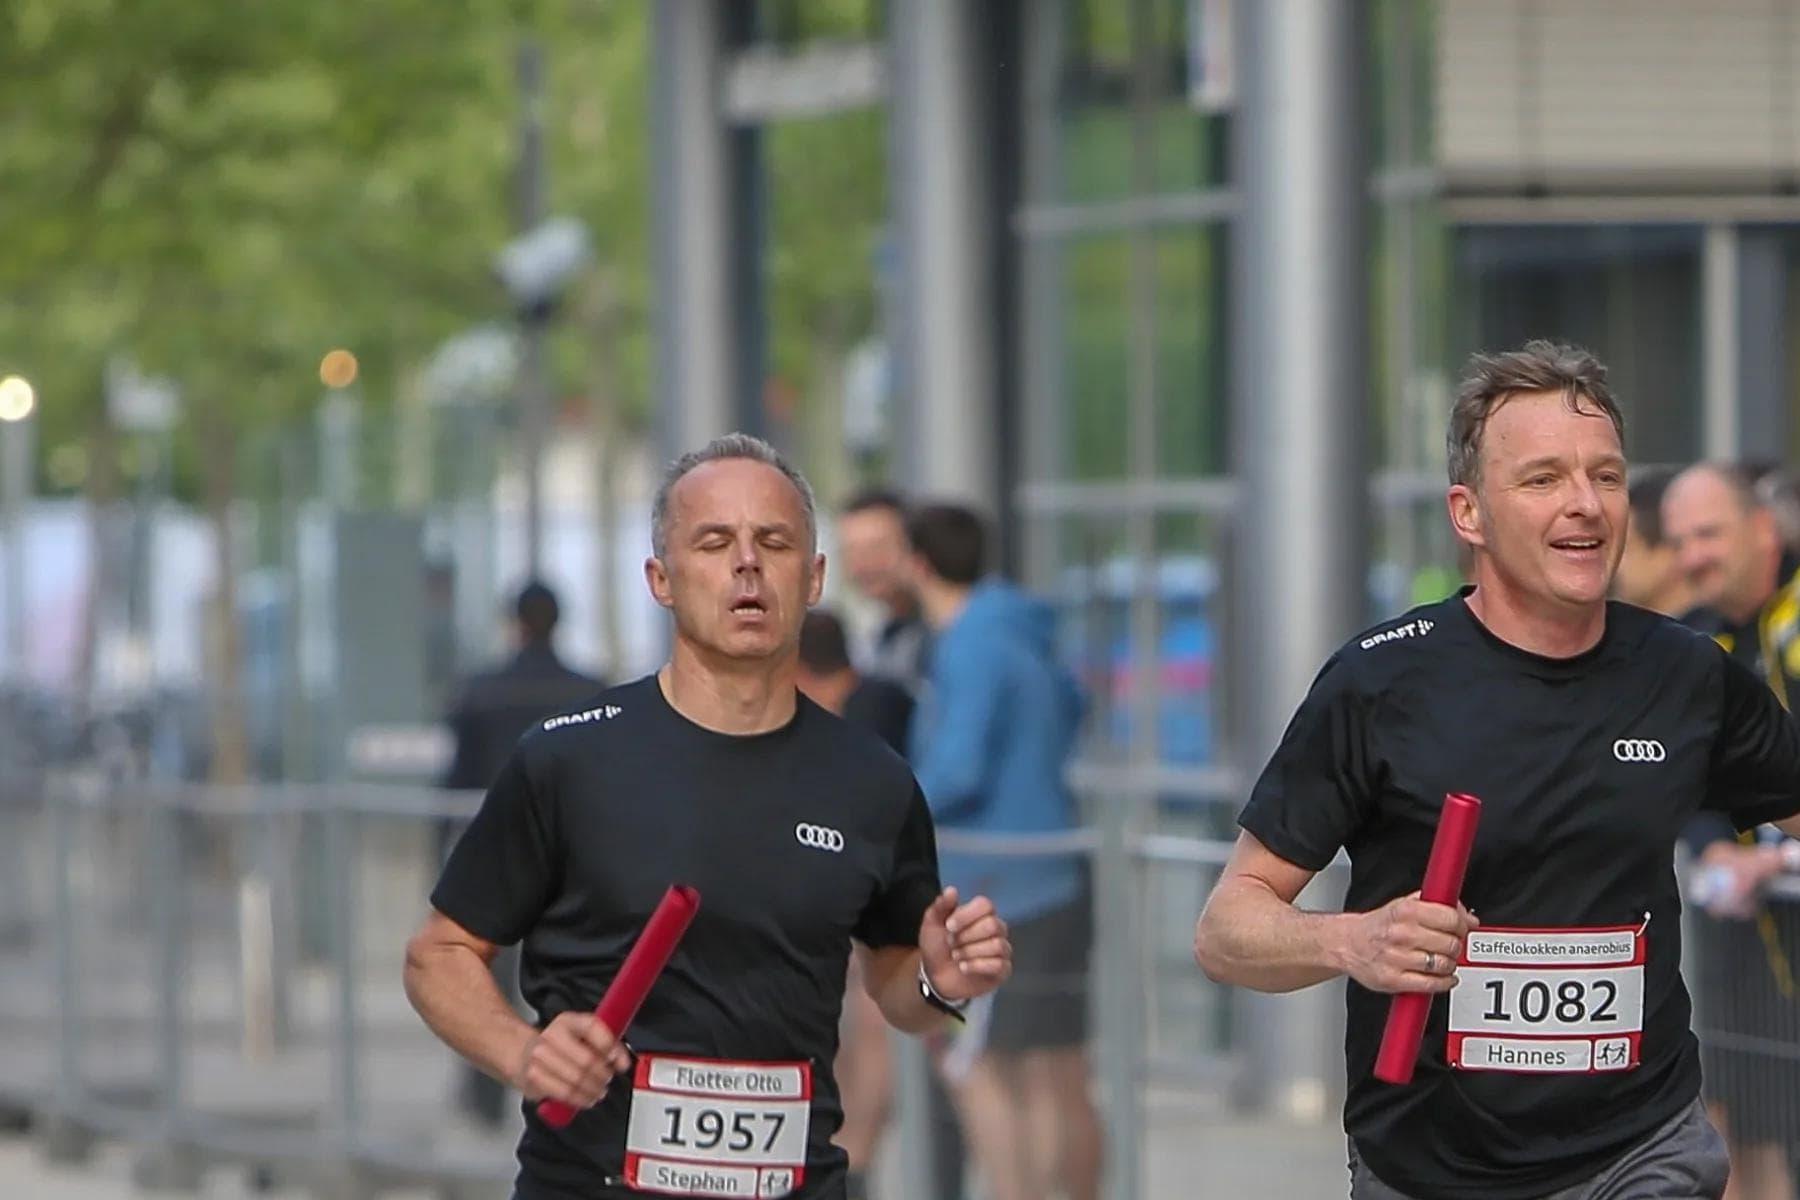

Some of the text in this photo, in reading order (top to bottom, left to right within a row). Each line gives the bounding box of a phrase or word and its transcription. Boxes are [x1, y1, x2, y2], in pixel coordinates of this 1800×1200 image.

[1472, 940, 1631, 955] Staffelokokken anaerobius
[1484, 980, 1618, 1023] 1082
[1488, 1044, 1566, 1066] Hannes
[676, 1066, 783, 1093] Flotter Otto
[660, 1106, 786, 1154] 1957
[656, 1166, 738, 1194] Stephan
